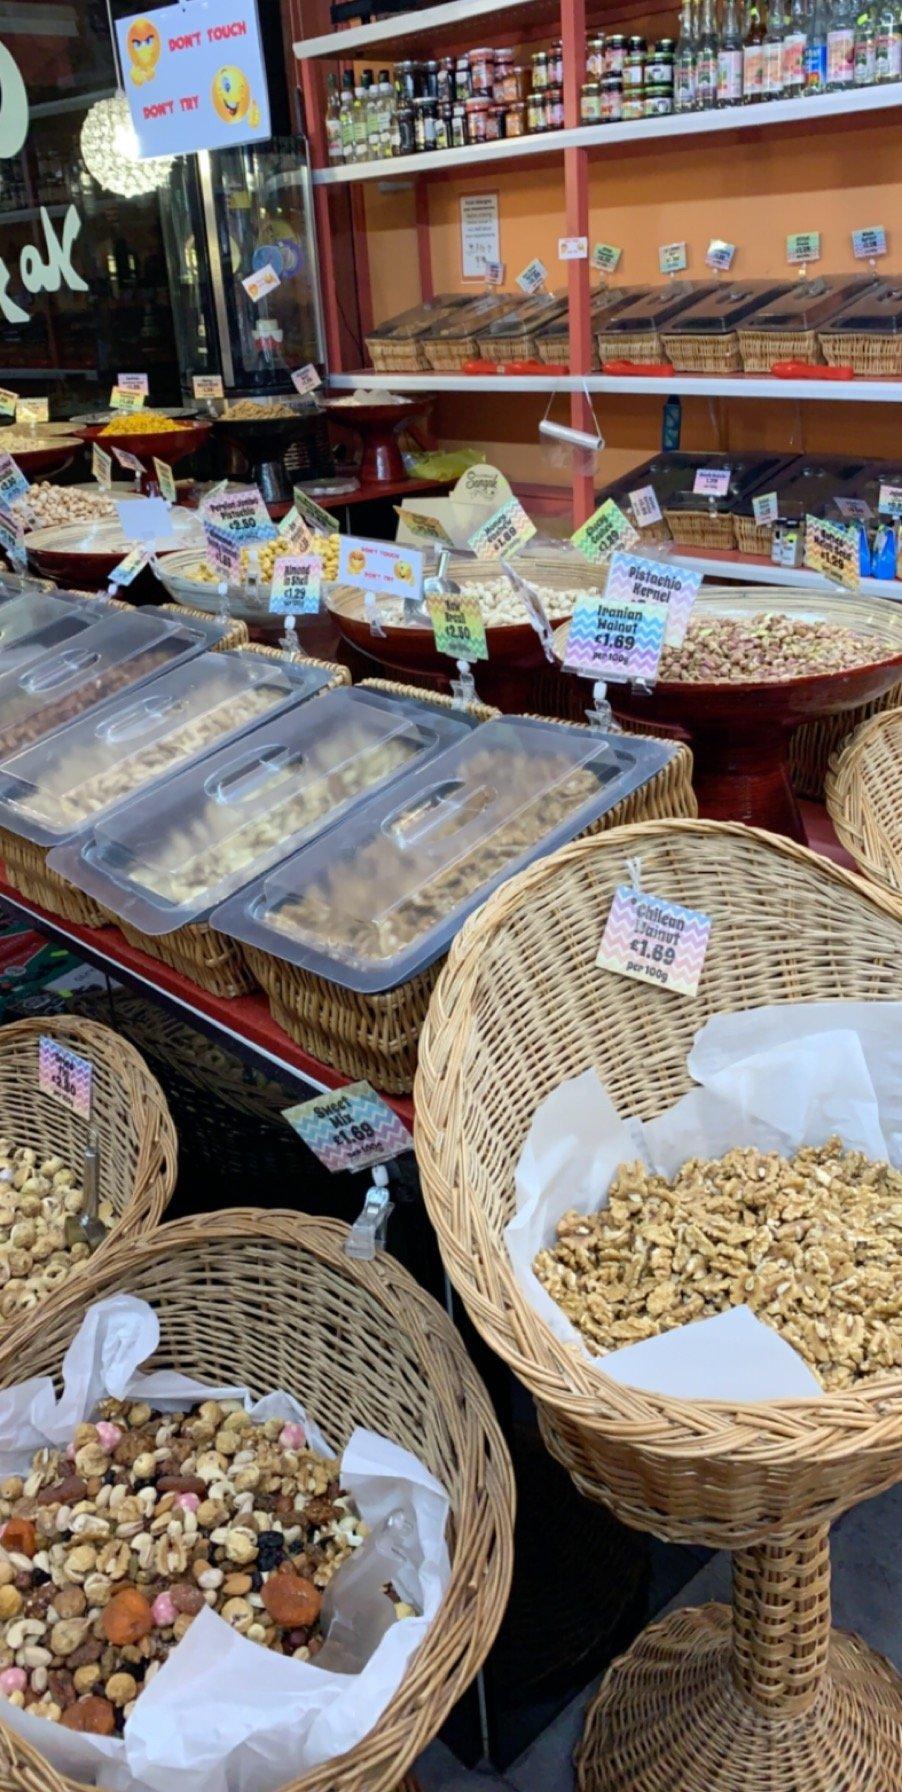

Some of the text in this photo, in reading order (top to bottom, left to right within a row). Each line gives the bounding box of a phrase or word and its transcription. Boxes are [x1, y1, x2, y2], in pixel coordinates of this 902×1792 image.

[168, 21, 247, 51] DON'T TOUCH
[143, 95, 199, 119] DON'T TRY
[629, 566, 682, 591] Pistachio
[633, 582, 671, 603] Kernel
[598, 605, 643, 622] Iranian
[597, 618, 638, 635] Walnut
[593, 652, 629, 665] per 100g
[637, 904, 685, 931] Chilean
[626, 961, 669, 983] per 100g
[314, 1096, 352, 1119] Sweet
[329, 1111, 354, 1129] Mix
